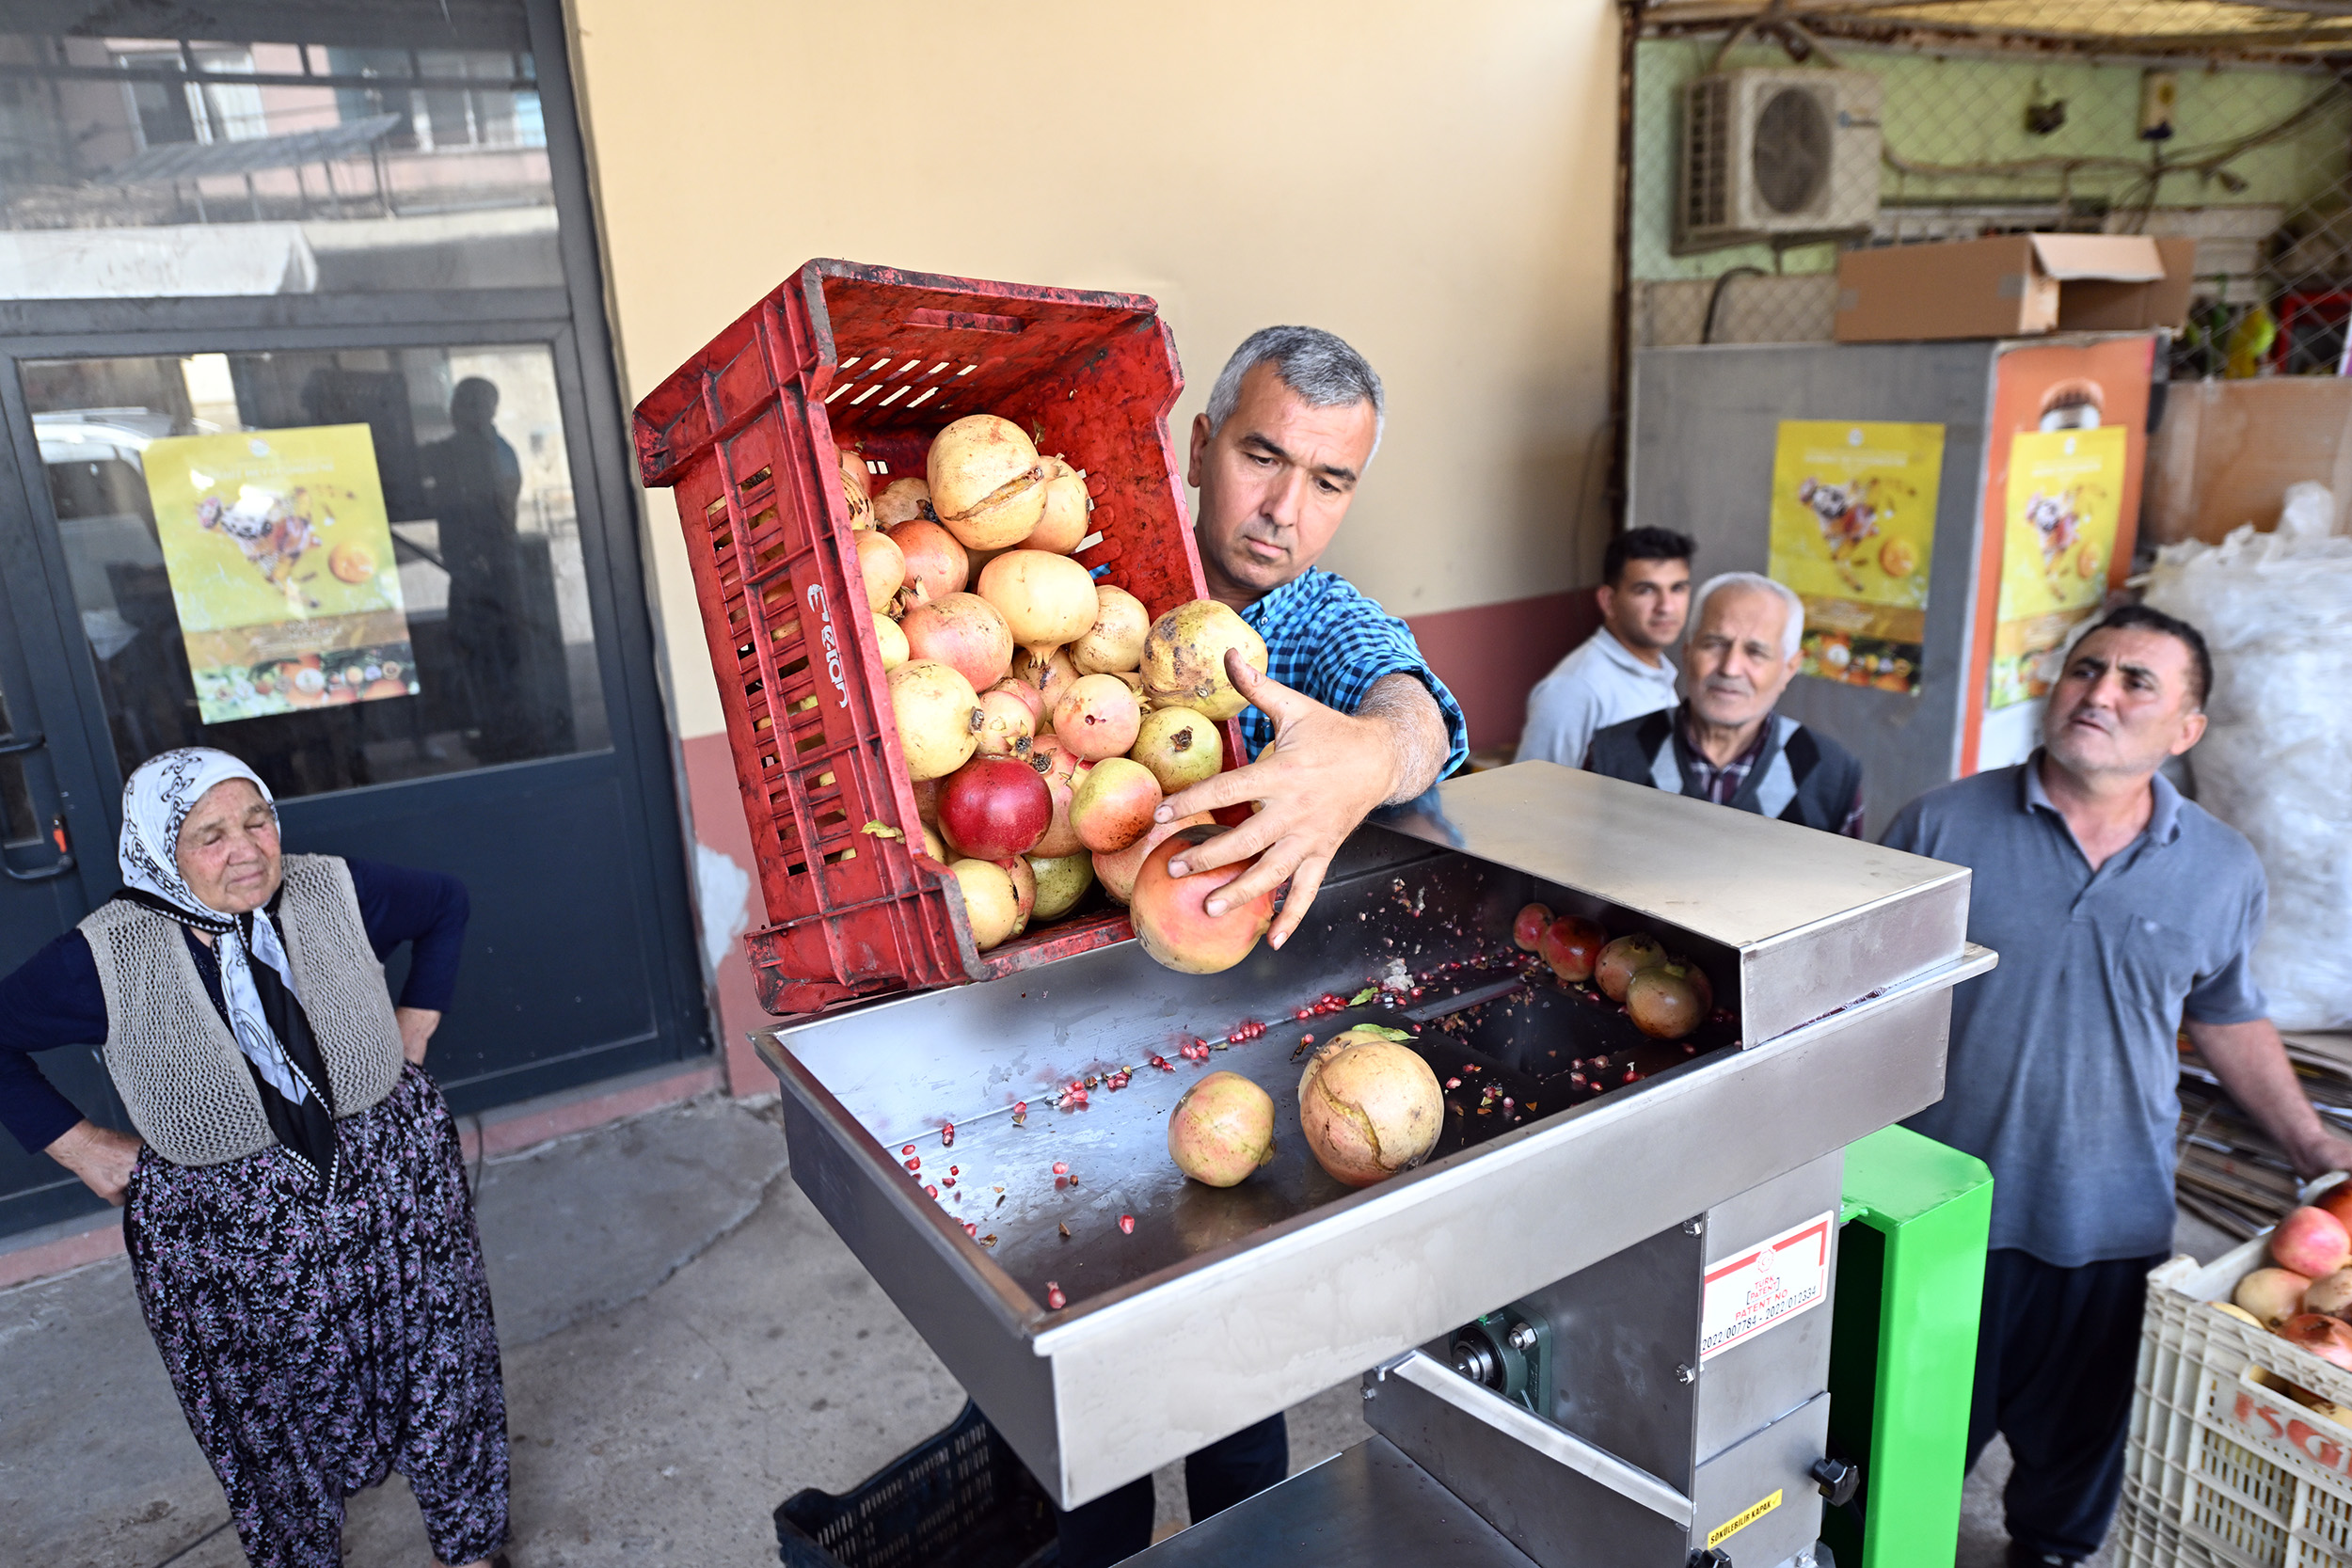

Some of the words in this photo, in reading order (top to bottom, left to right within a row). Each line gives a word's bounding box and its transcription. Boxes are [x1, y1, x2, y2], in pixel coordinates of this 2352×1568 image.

[1702, 1315, 1756, 1351] 2022/007784
[1766, 1286, 1817, 1320] 2022/012334
[1736, 1297, 1772, 1321] PATENT
[1775, 1290, 1788, 1302] NO
[1710, 1513, 1751, 1544] SÖKÜLEBİLİR
[1751, 1500, 1772, 1519] KAPAK
